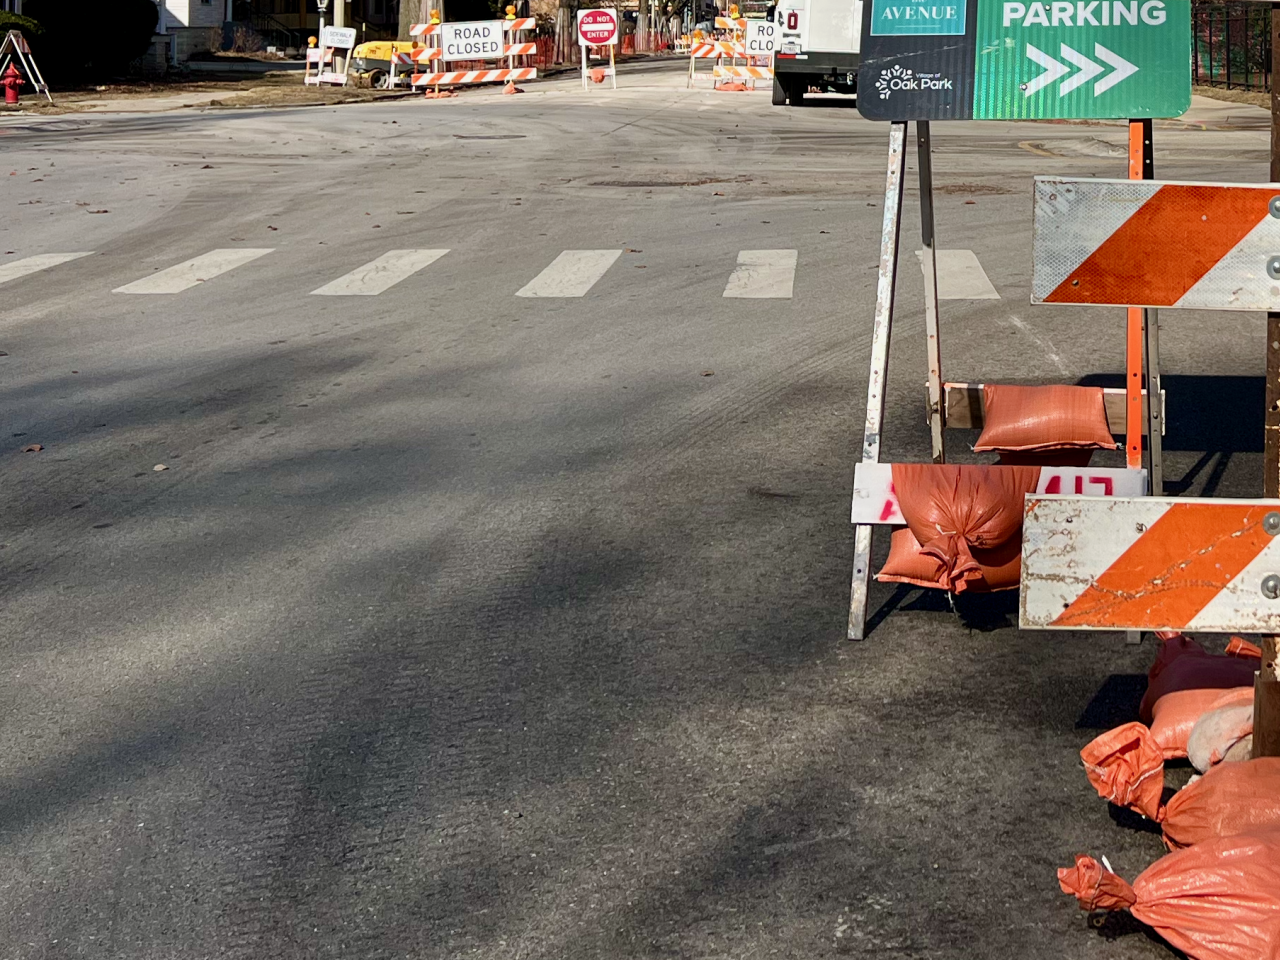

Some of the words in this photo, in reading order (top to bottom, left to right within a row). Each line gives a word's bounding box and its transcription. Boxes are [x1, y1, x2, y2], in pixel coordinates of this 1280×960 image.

[881, 5, 957, 20] AVENUE
[1002, 0, 1167, 27] PARKING
[454, 27, 490, 39] ROAD
[758, 26, 773, 35] RO
[447, 42, 498, 54] CLOSED
[750, 40, 773, 51] CLO
[890, 79, 918, 90] Oak
[921, 78, 953, 90] Park
